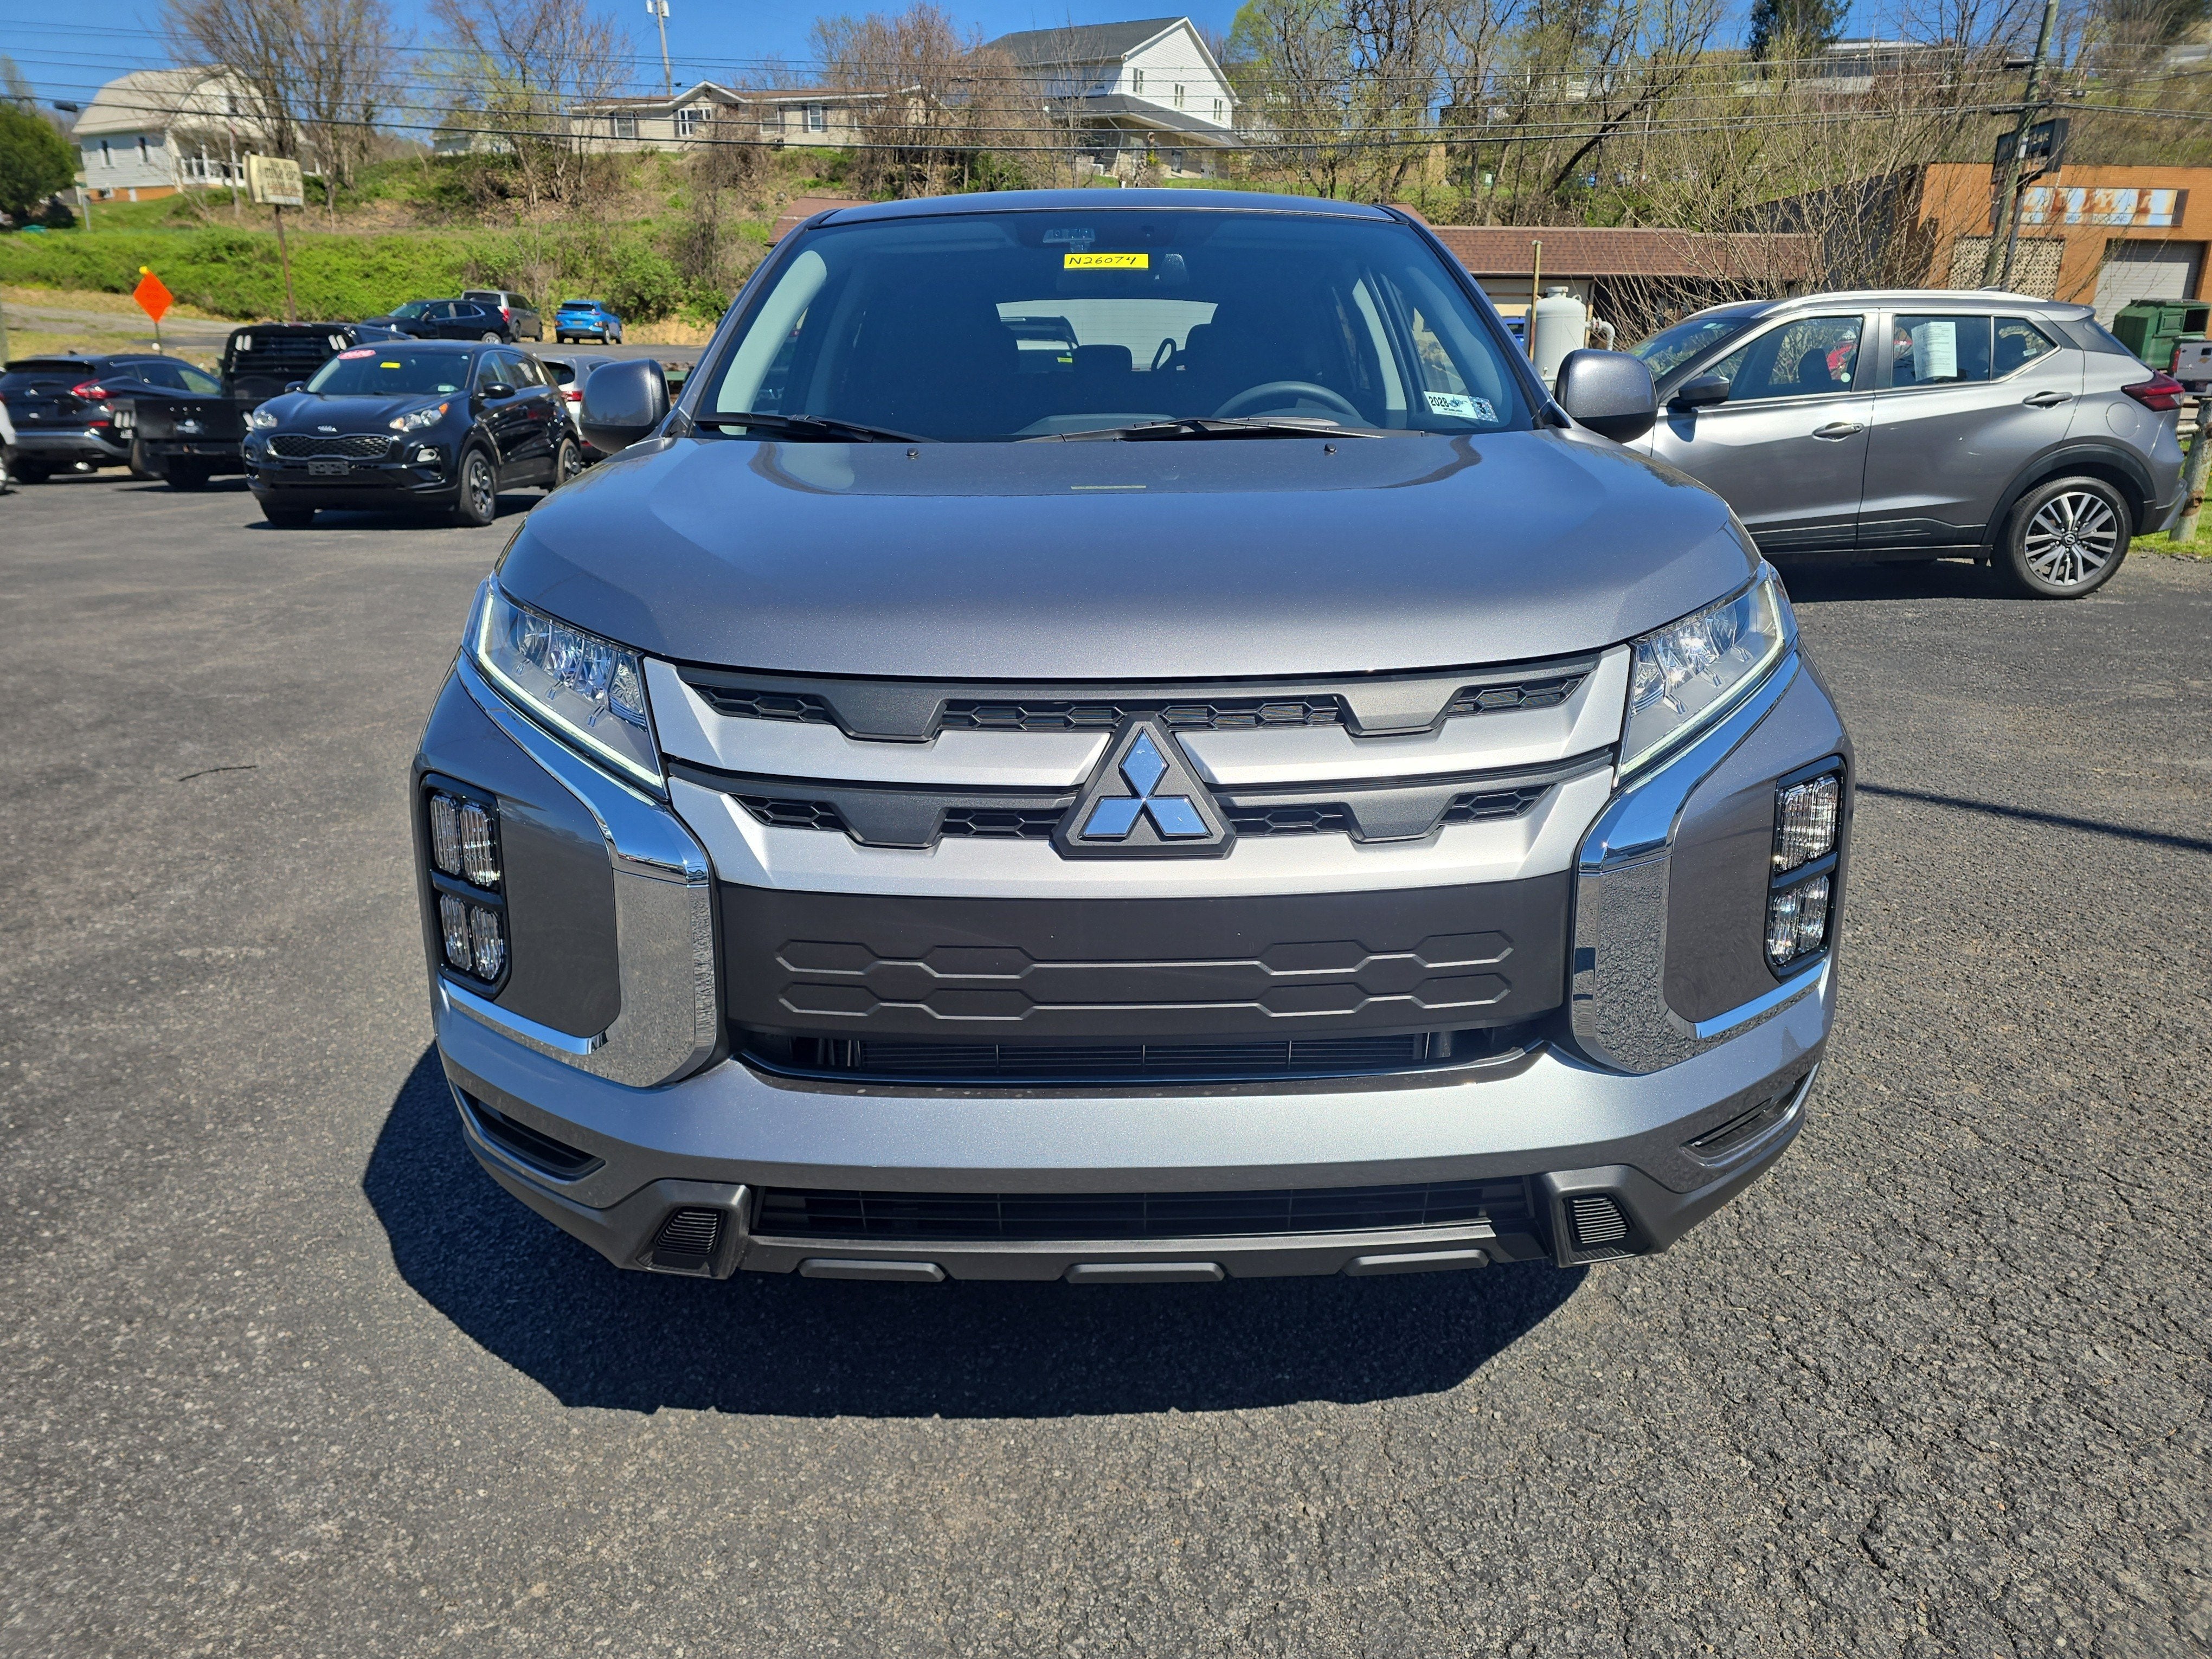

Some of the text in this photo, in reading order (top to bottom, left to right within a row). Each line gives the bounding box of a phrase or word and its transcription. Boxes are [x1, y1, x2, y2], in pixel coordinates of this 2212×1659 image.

[1069, 256, 1136, 265] N26074
[1429, 396, 1449, 407] 2028
[1476, 402, 1487, 414] 3
